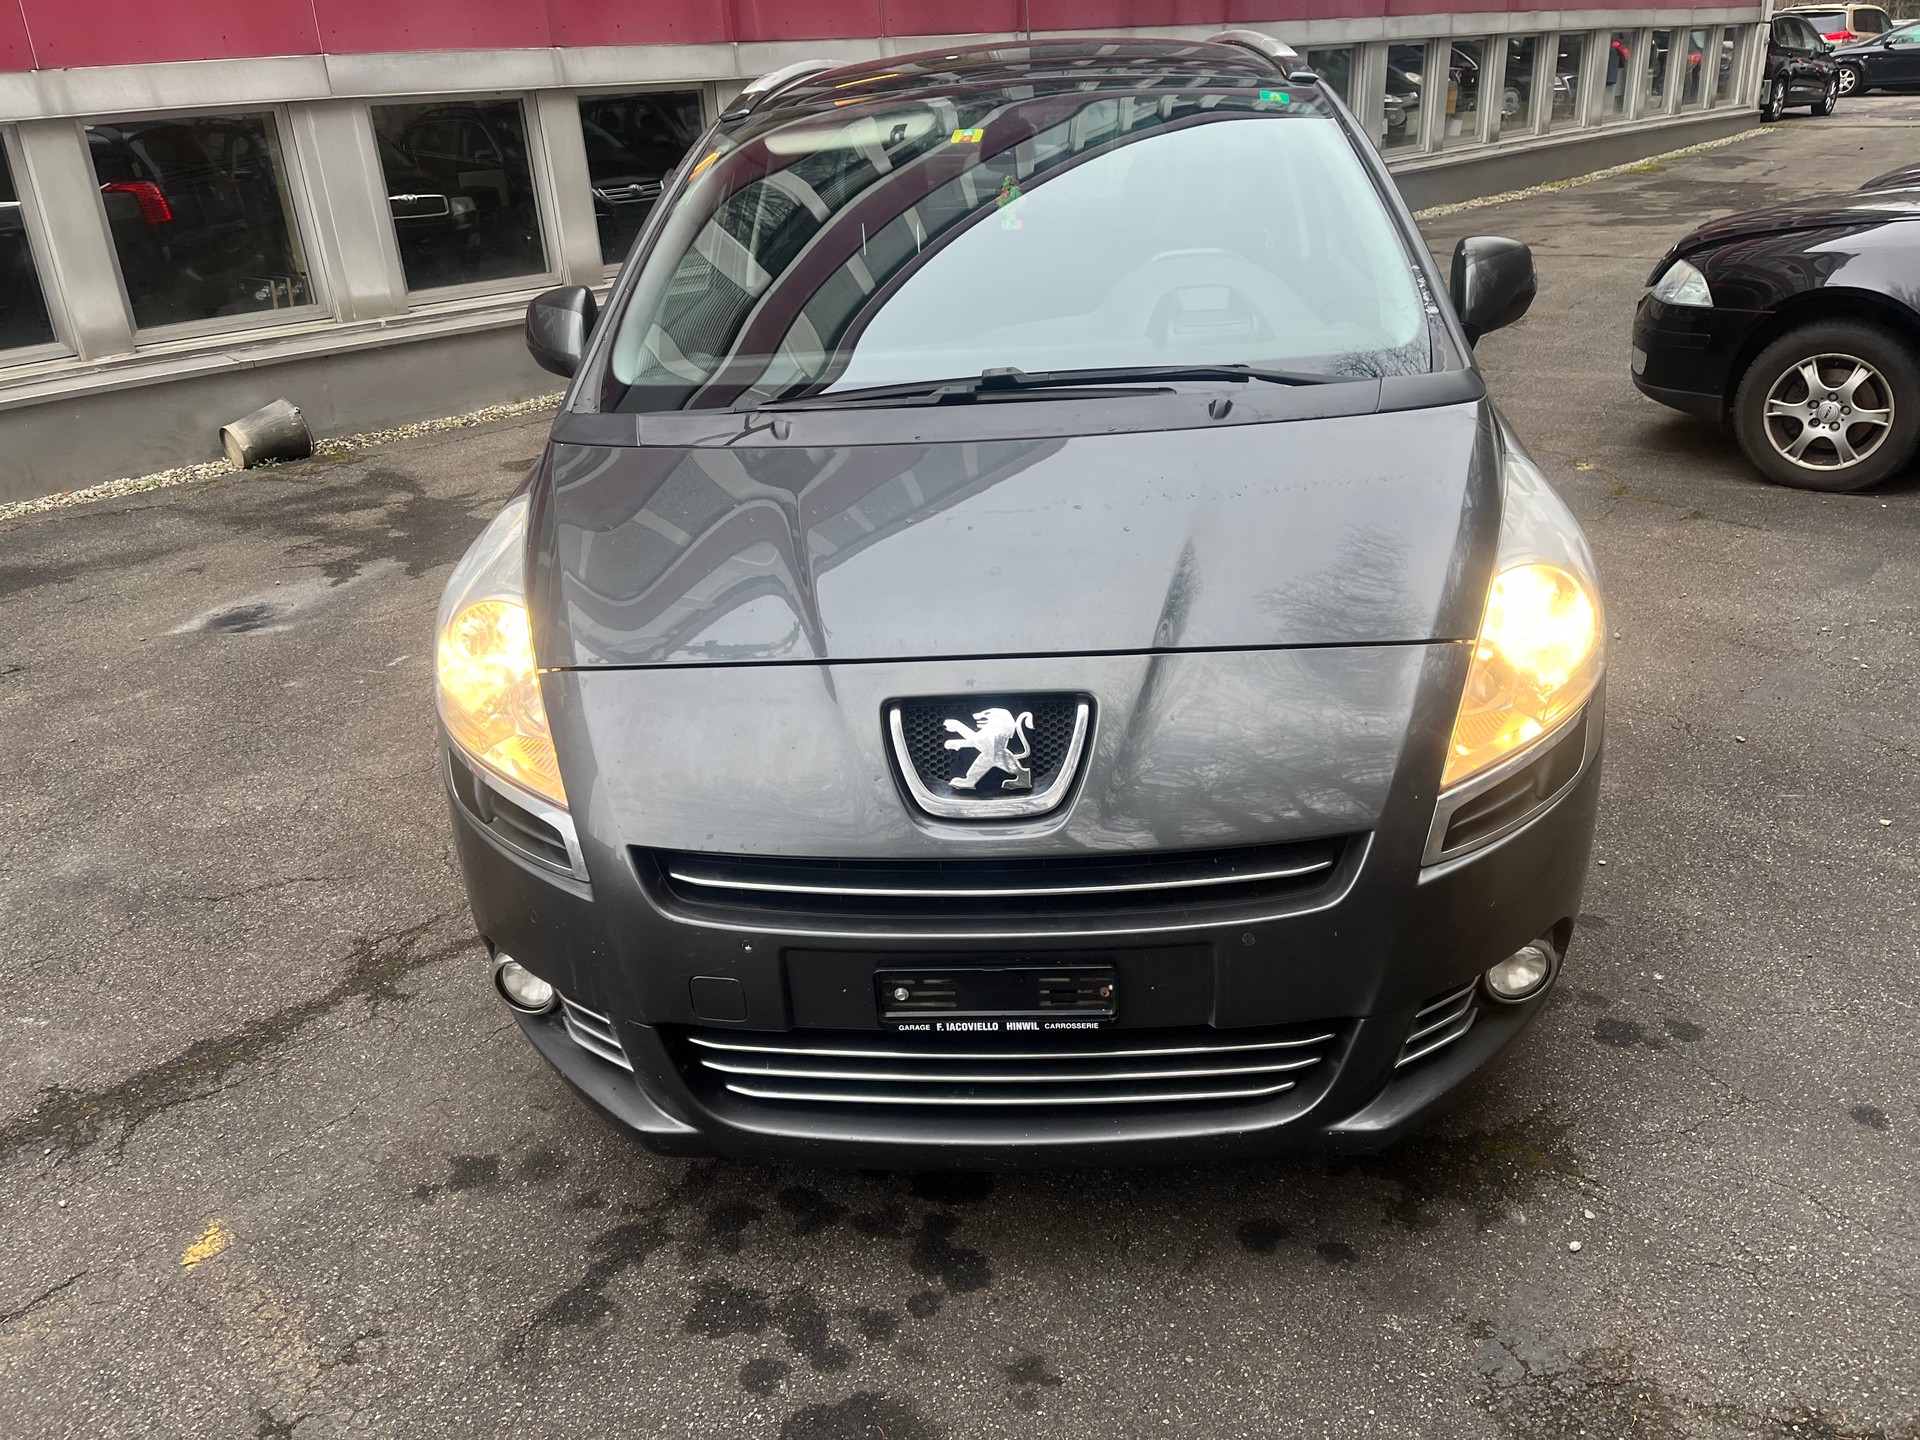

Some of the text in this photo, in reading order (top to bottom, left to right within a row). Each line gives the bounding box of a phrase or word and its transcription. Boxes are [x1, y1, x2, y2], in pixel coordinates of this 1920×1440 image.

[936, 1023, 945, 1031] F.
[946, 1022, 999, 1031] IACOVIELLO
[1006, 1021, 1040, 1031] HINWIL
